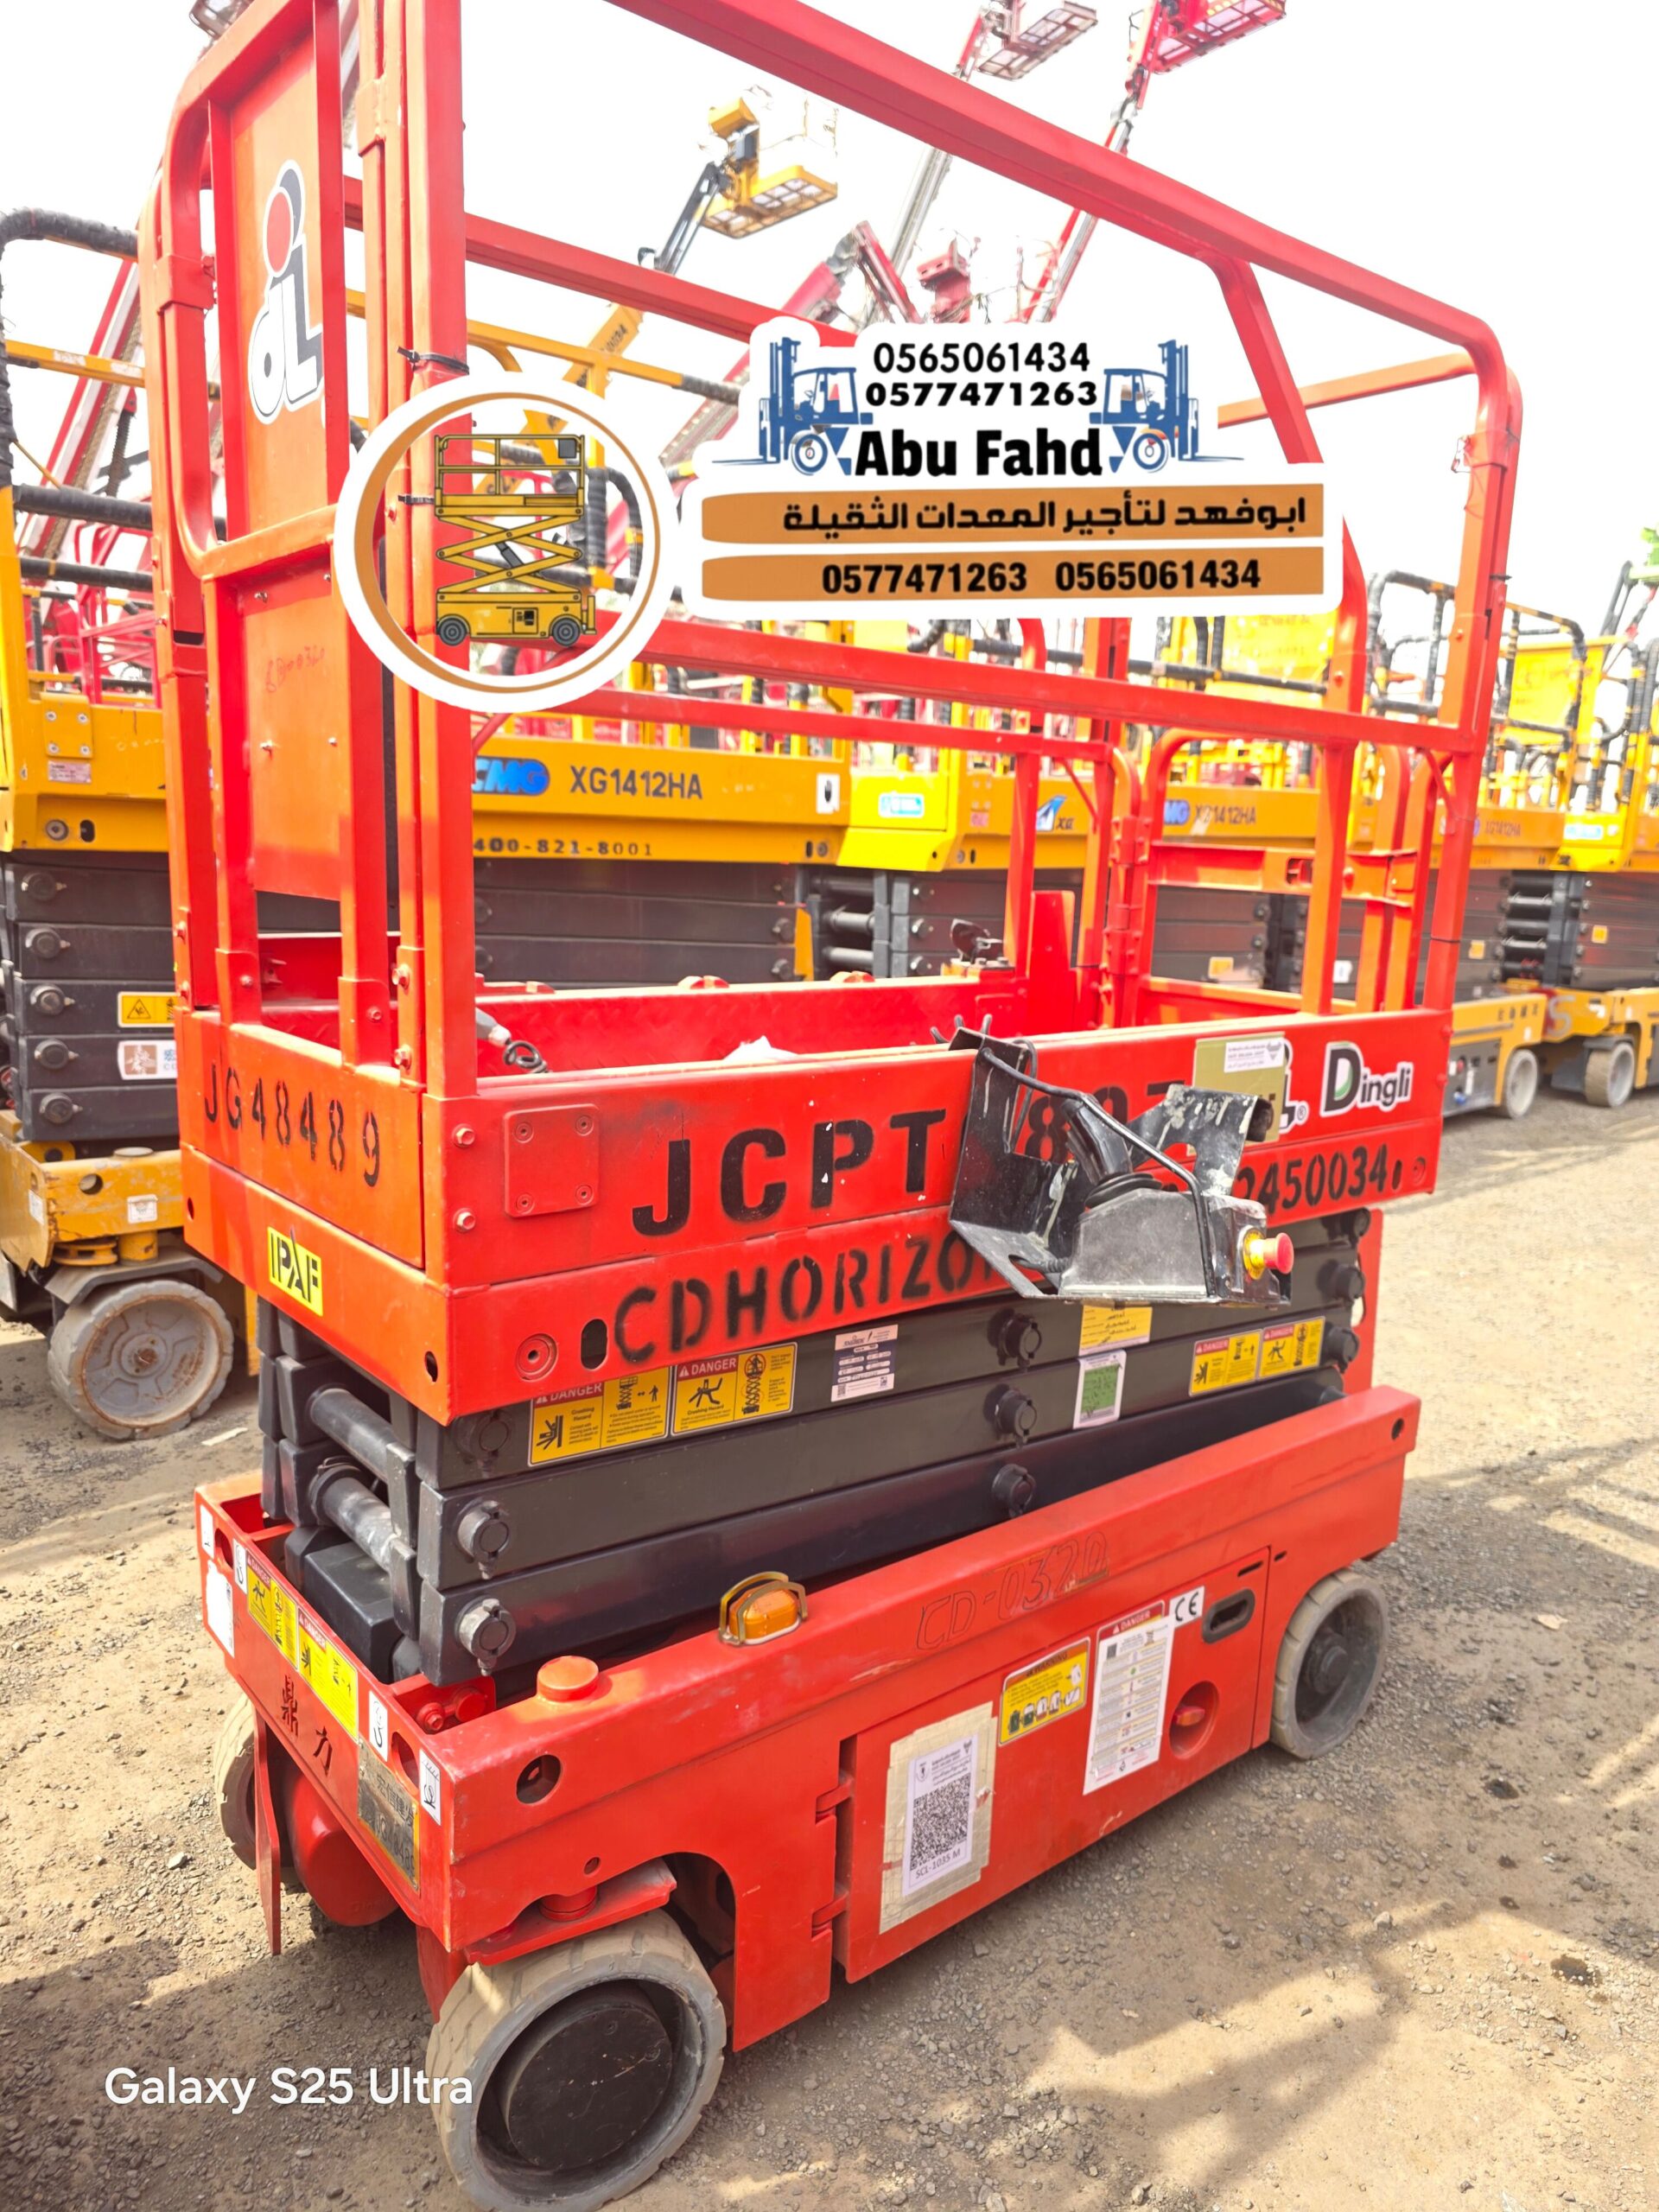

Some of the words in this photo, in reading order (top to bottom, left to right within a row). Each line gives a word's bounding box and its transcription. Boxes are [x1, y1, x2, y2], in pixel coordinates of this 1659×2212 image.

[472, 757, 549, 795] CMG
[570, 766, 702, 799] XG1412HA
[1324, 1046, 1411, 1113] Dingli
[204, 1064, 380, 1187] JG48489
[270, 1224, 320, 1304] IPAF
[614, 1230, 990, 1364] CDHORIZO
[691, 1357, 736, 1376] DANGER
